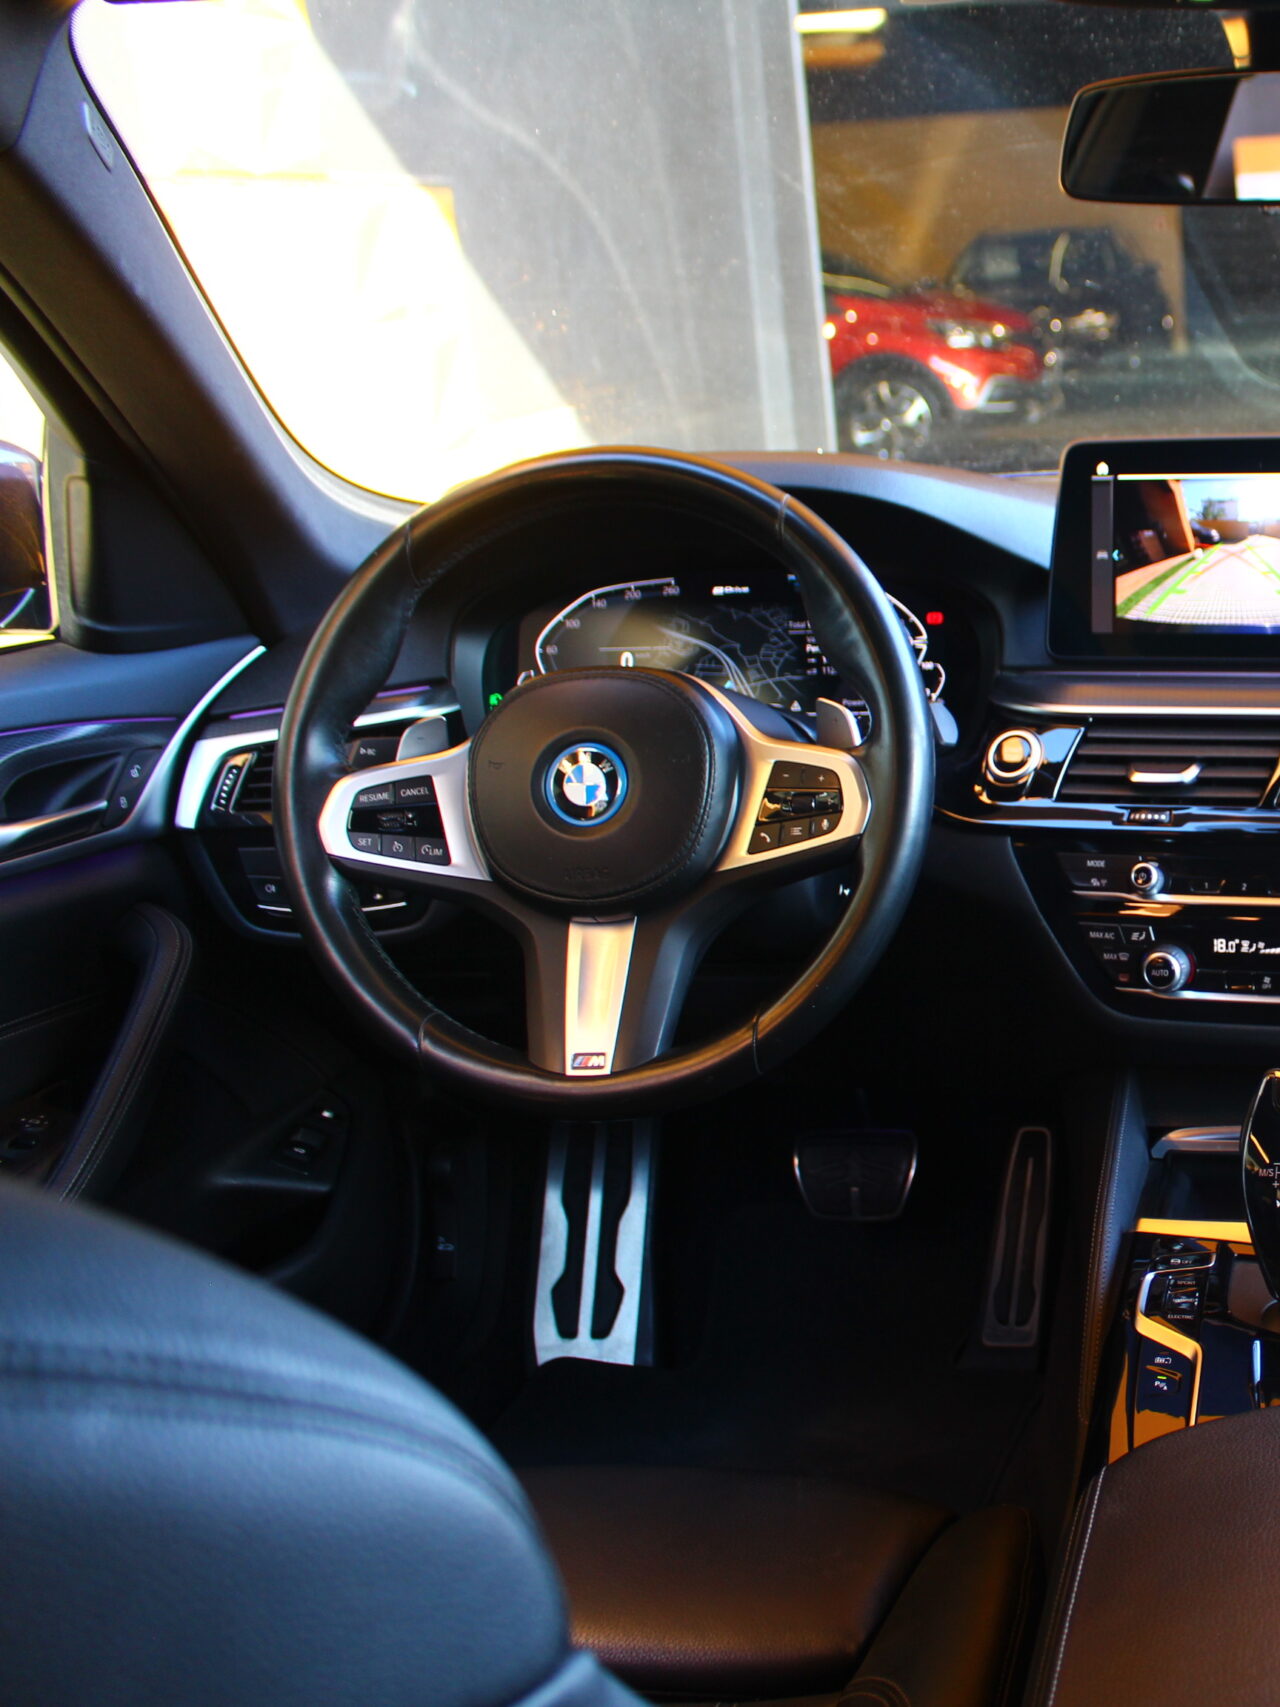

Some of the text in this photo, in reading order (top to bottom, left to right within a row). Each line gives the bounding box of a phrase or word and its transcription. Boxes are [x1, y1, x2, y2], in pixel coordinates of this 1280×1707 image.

[624, 590, 642, 600] 200
[662, 586, 680, 597] 260
[564, 619, 581, 629] 100
[359, 791, 390, 803] RESUME
[400, 786, 430, 798] CANCEL
[358, 837, 373, 847] SET
[1086, 860, 1106, 868] MODE
[1241, 883, 1247, 891] 2
[1151, 969, 1169, 977] AUTO
[1259, 1168, 1274, 1177] M/S
